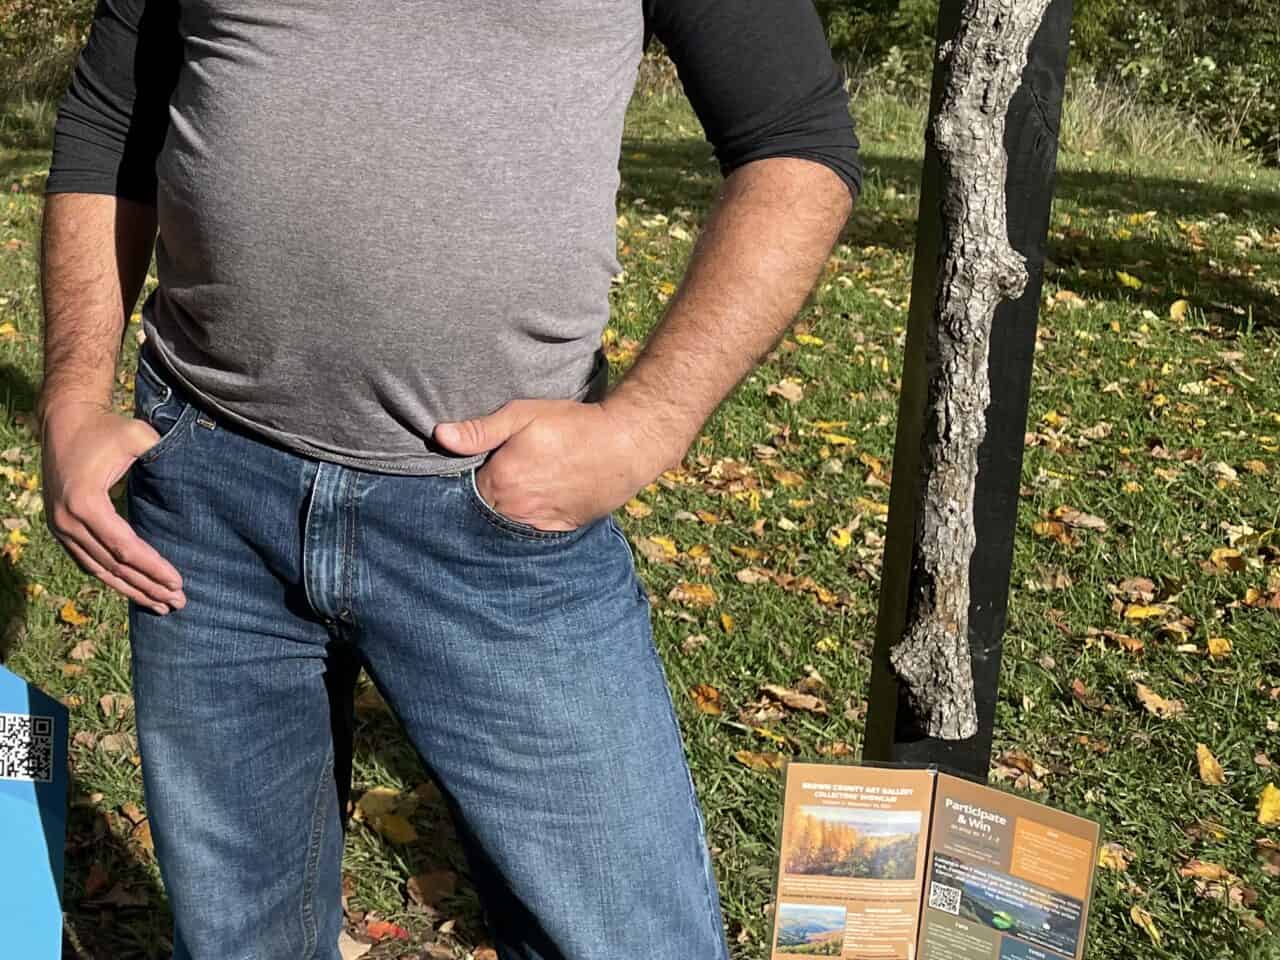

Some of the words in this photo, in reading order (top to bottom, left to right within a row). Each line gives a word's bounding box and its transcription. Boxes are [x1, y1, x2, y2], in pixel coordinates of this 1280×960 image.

[945, 798, 1007, 826] Participate
[957, 814, 967, 825] &
[968, 816, 992, 833] Win
